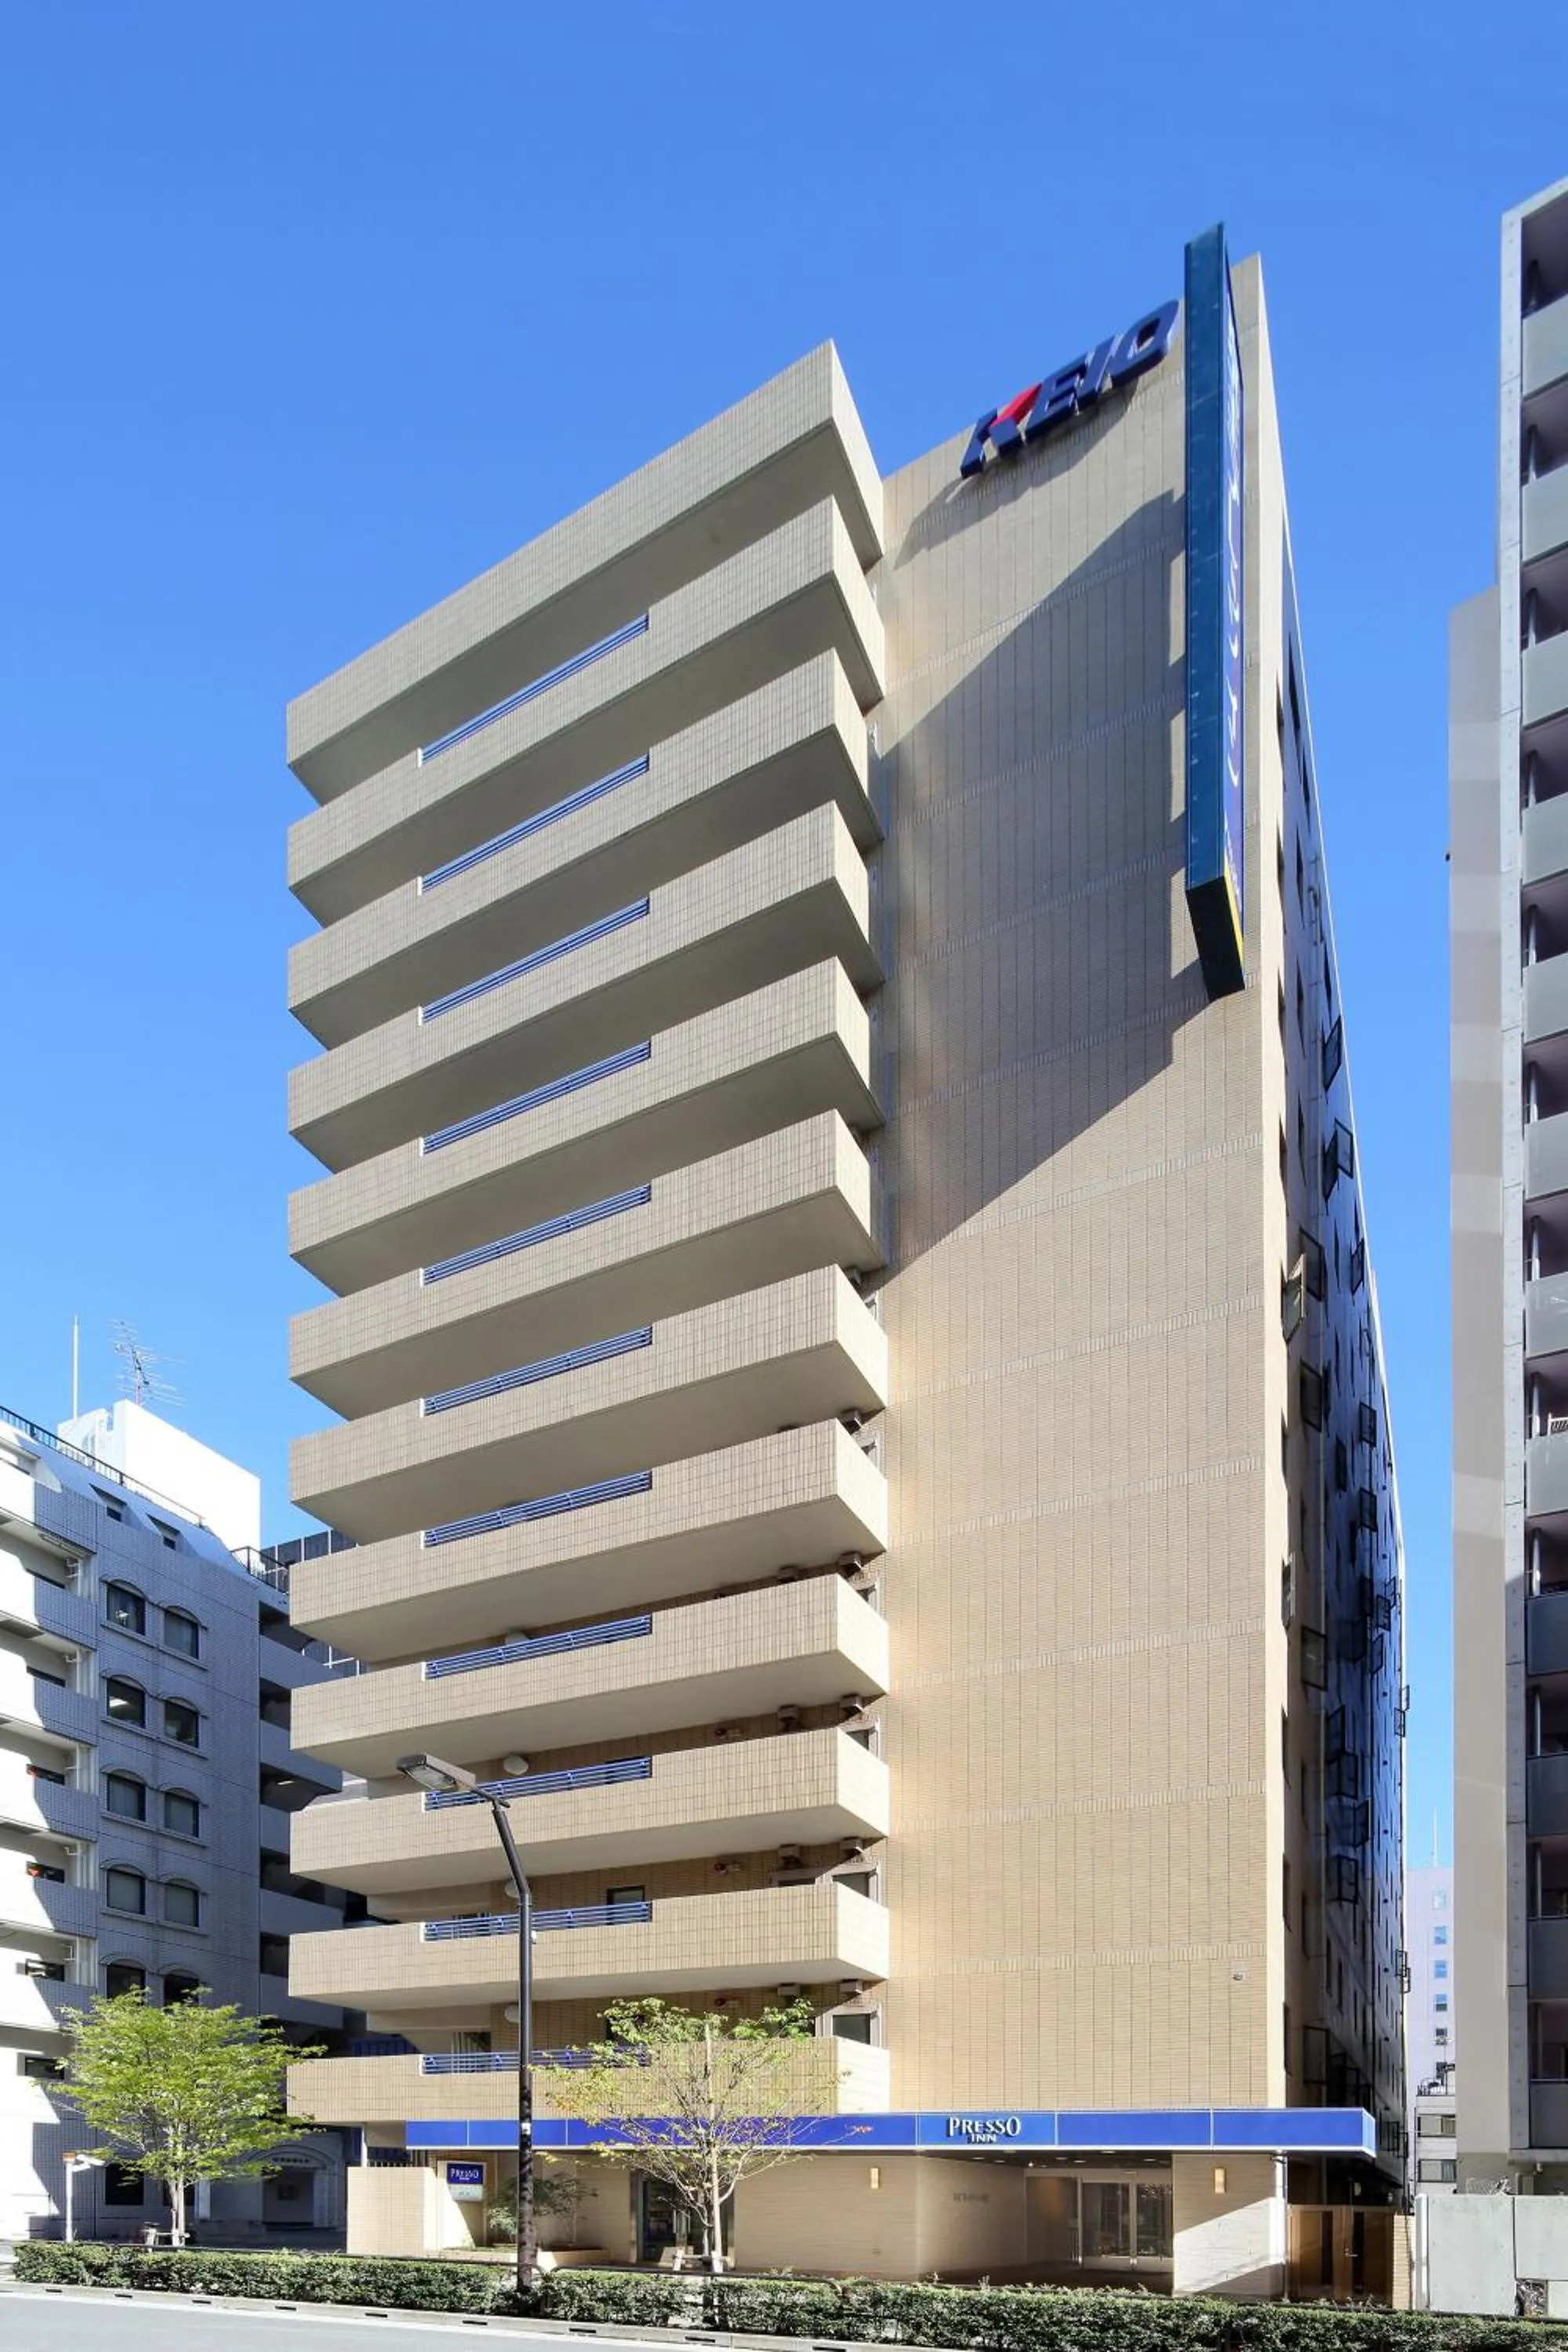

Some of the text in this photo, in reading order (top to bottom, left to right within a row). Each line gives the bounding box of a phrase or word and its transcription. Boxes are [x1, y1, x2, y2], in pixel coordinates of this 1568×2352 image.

[960, 299, 1179, 480] KEIO
[947, 2116, 1021, 2137] PRESSO
[970, 2133, 997, 2143] INN
